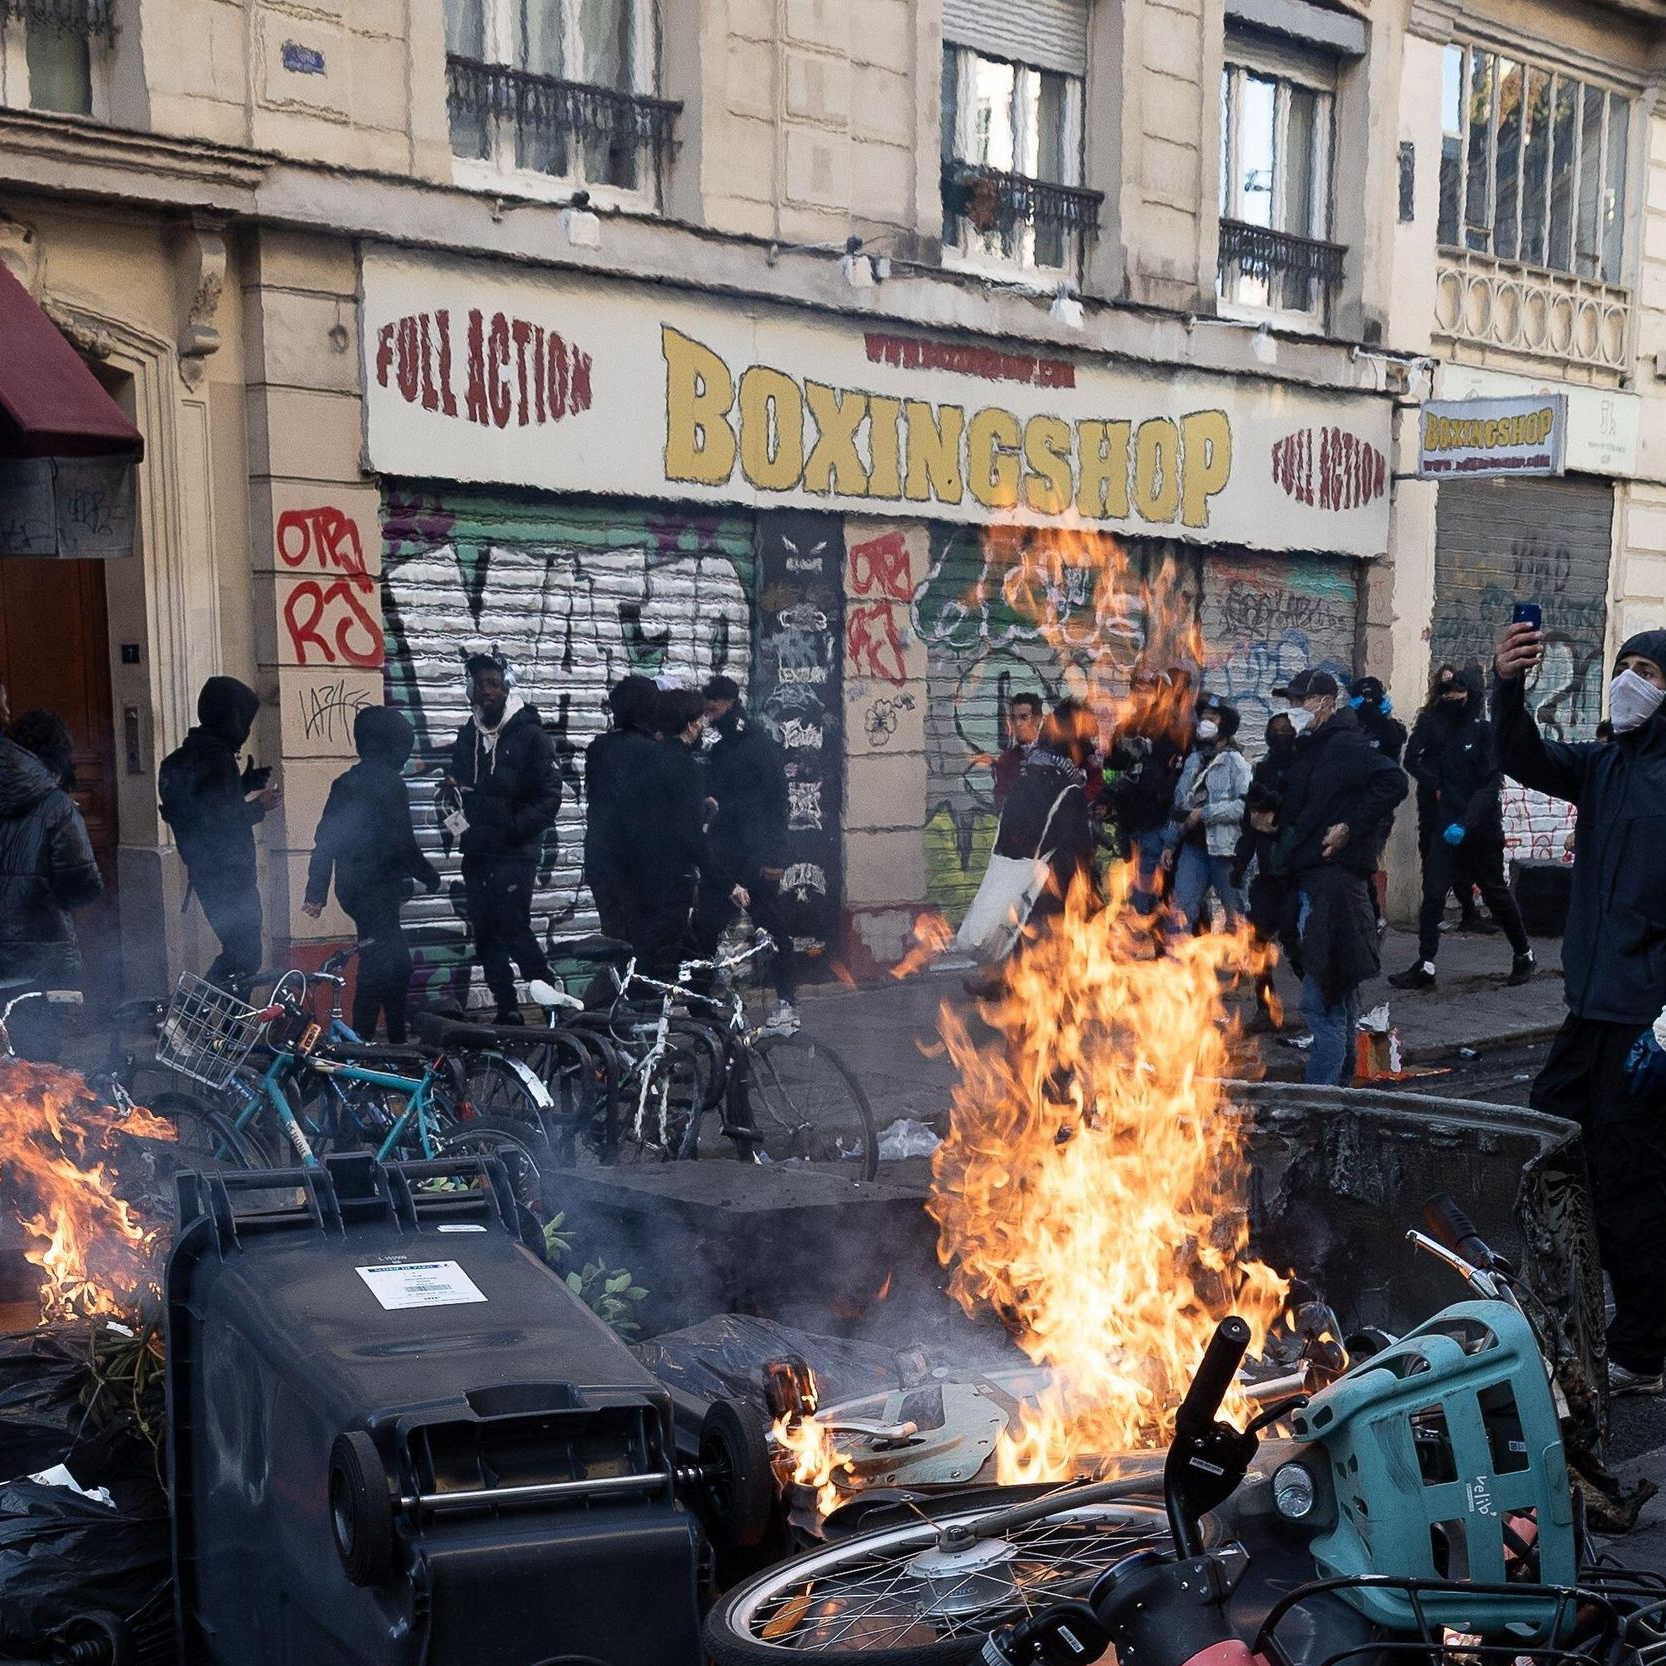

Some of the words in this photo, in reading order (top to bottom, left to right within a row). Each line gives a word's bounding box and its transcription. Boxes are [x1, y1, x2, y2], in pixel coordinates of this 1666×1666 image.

[376, 309, 459, 418] FULL
[466, 309, 594, 429] ACTION
[661, 323, 1232, 528] BOXINGSHOP
[1270, 427, 1314, 506] FULL
[1318, 424, 1386, 512] ACTION
[1424, 406, 1555, 452] BOXINGSHOP
